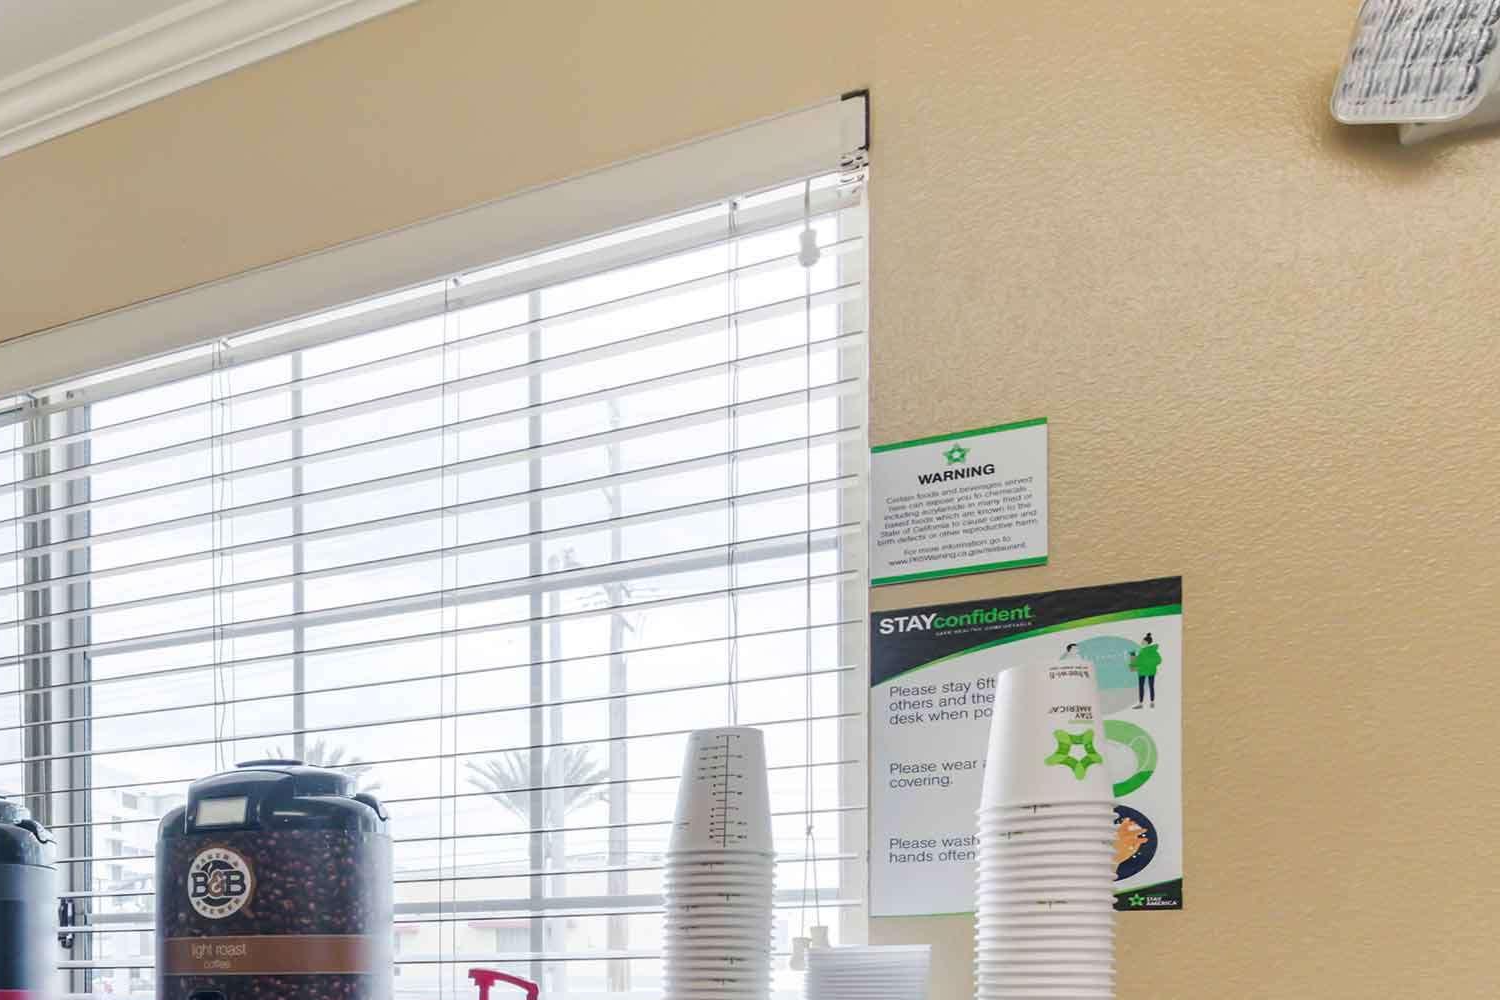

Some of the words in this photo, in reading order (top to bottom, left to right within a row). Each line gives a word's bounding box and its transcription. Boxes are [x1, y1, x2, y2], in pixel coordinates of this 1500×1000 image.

[918, 464, 995, 485] WARNING
[889, 685, 937, 697] Please
[942, 680, 971, 693] stay
[976, 678, 995, 689] 6ft
[889, 699, 933, 712] others
[939, 695, 966, 707] and
[971, 692, 995, 704] the
[889, 712, 924, 725] desk
[929, 709, 969, 722] when
[890, 762, 937, 774] Please
[942, 759, 978, 771] wear
[890, 775, 953, 789] covering.
[889, 837, 937, 849] Please
[942, 835, 980, 847] wash
[889, 851, 933, 864] hands
[938, 850, 976, 861] often
[191, 870, 246, 898] B&B
[218, 944, 247, 955] roast
